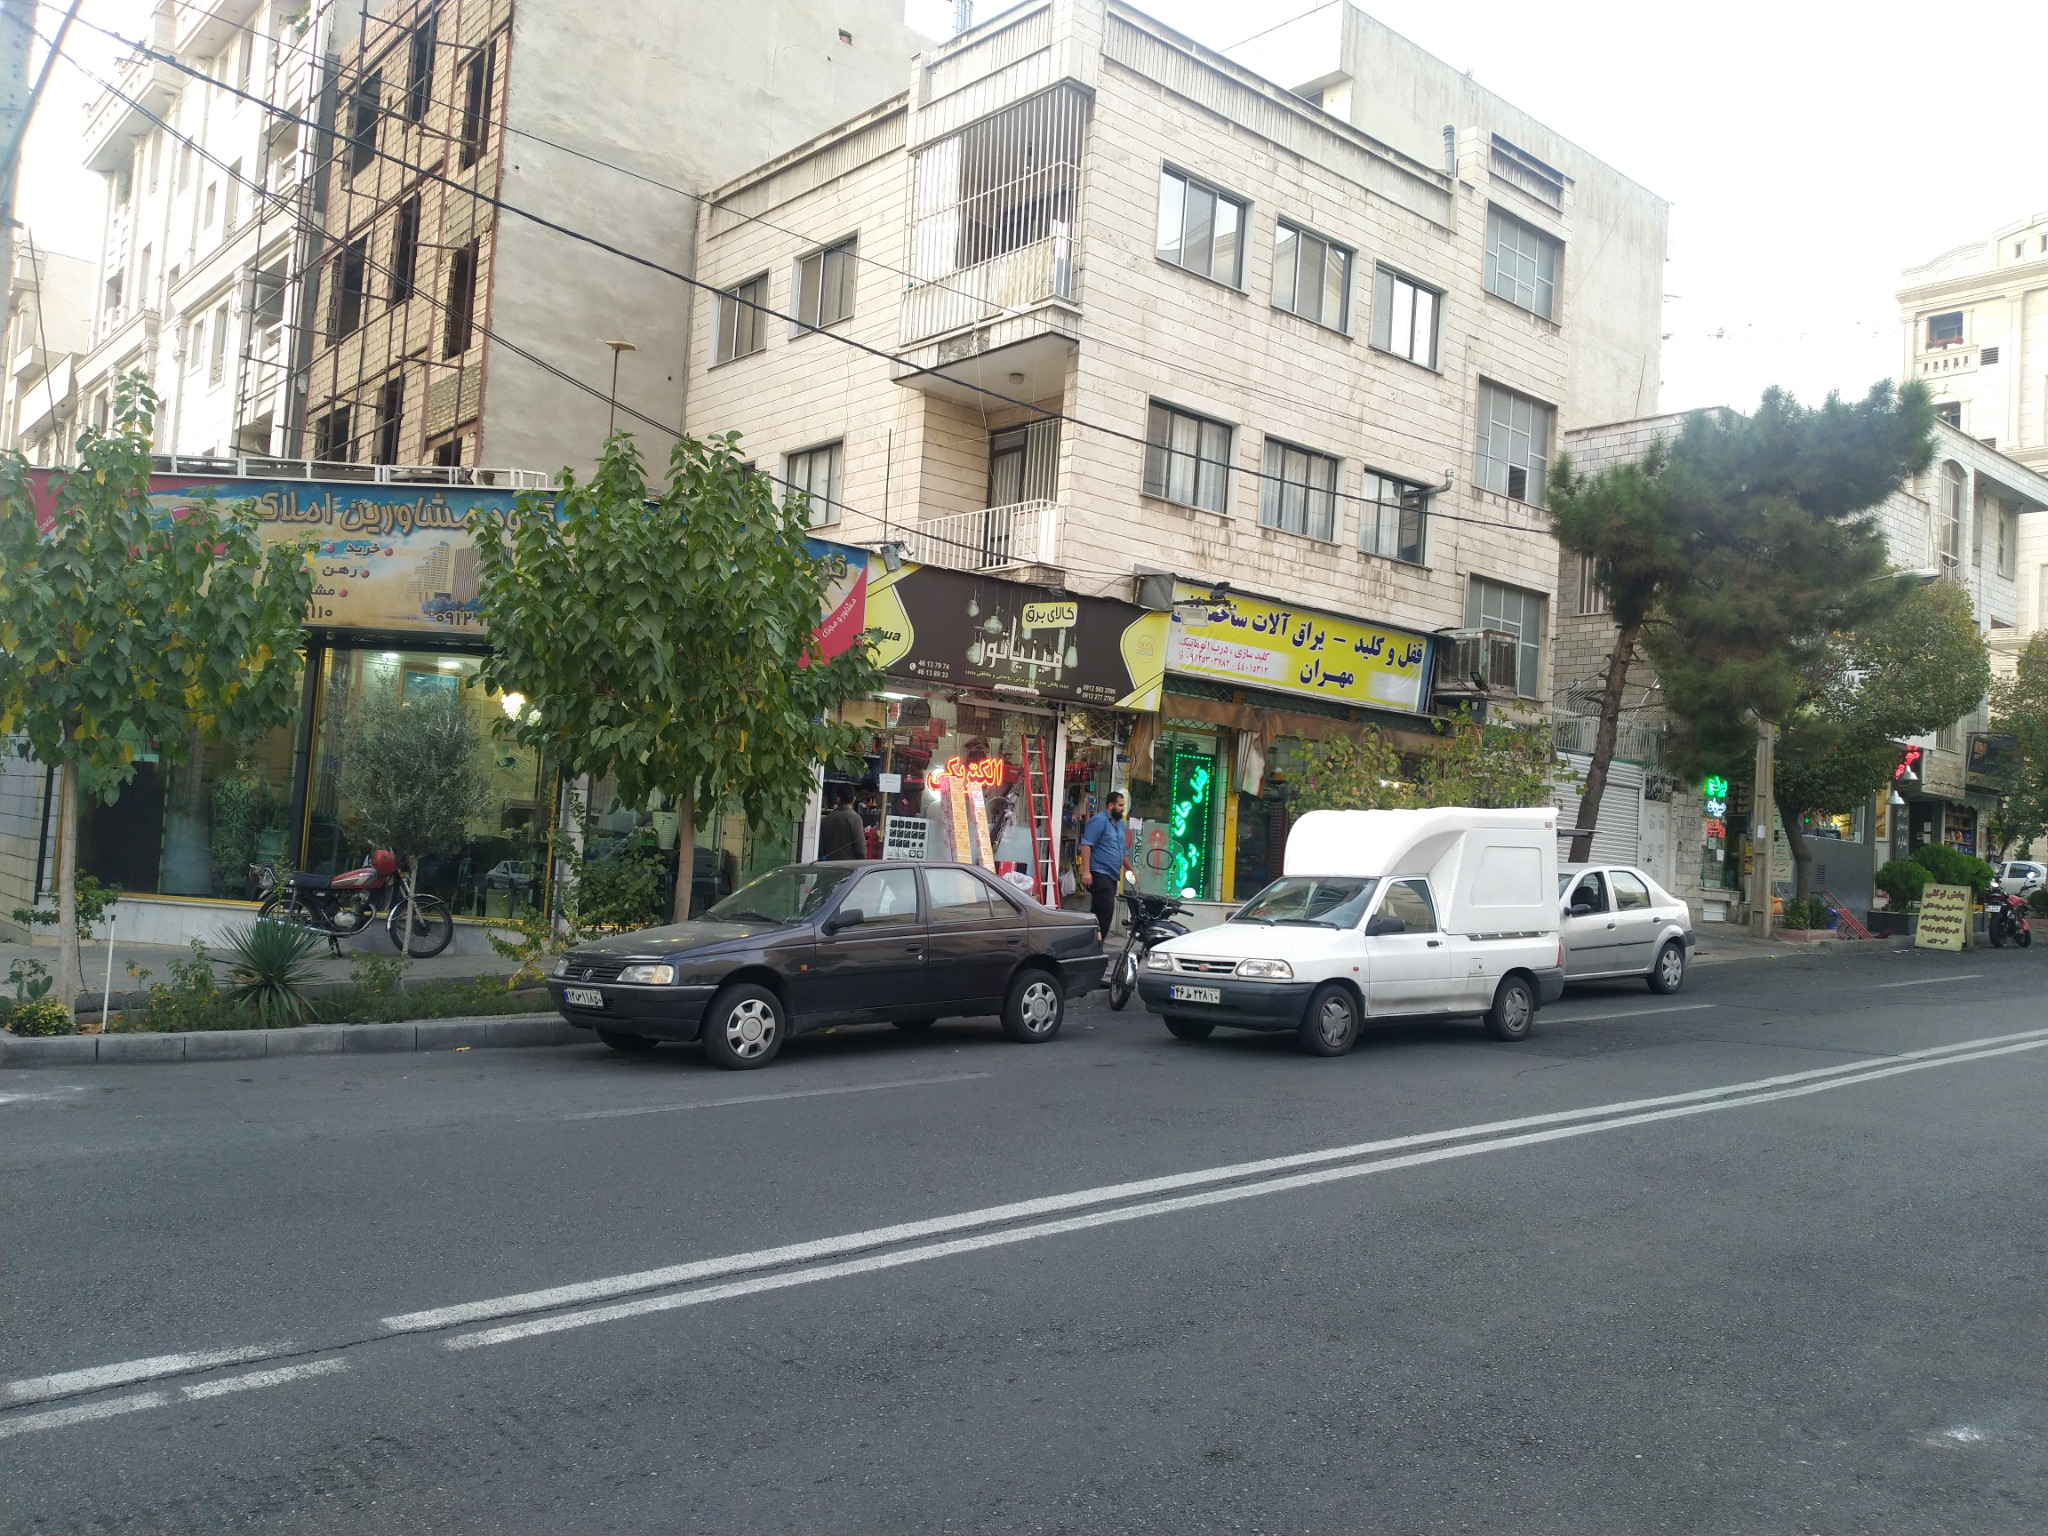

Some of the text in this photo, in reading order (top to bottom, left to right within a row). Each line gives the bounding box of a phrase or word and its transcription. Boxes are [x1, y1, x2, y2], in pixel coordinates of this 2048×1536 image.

[251, 491, 332, 523] املاک
[340, 492, 479, 536] مشاورین
[345, 543, 380, 556] خرید
[322, 566, 358, 578] رهن
[1025, 605, 1075, 624] کالای برق
[1251, 612, 1291, 636] آلات
[976, 614, 1063, 674] مینیاتور
[1291, 620, 1325, 651] یراق
[1354, 634, 1385, 660] کلید
[1211, 644, 1229, 656] درب
[1254, 651, 1271, 664] کلید
[1385, 647, 1395, 666] و
[1397, 642, 1423, 668] قفل
[1299, 657, 1354, 689] مهران
[927, 756, 1004, 794] الکتریکی
[1190, 765, 1208, 803] قفل
